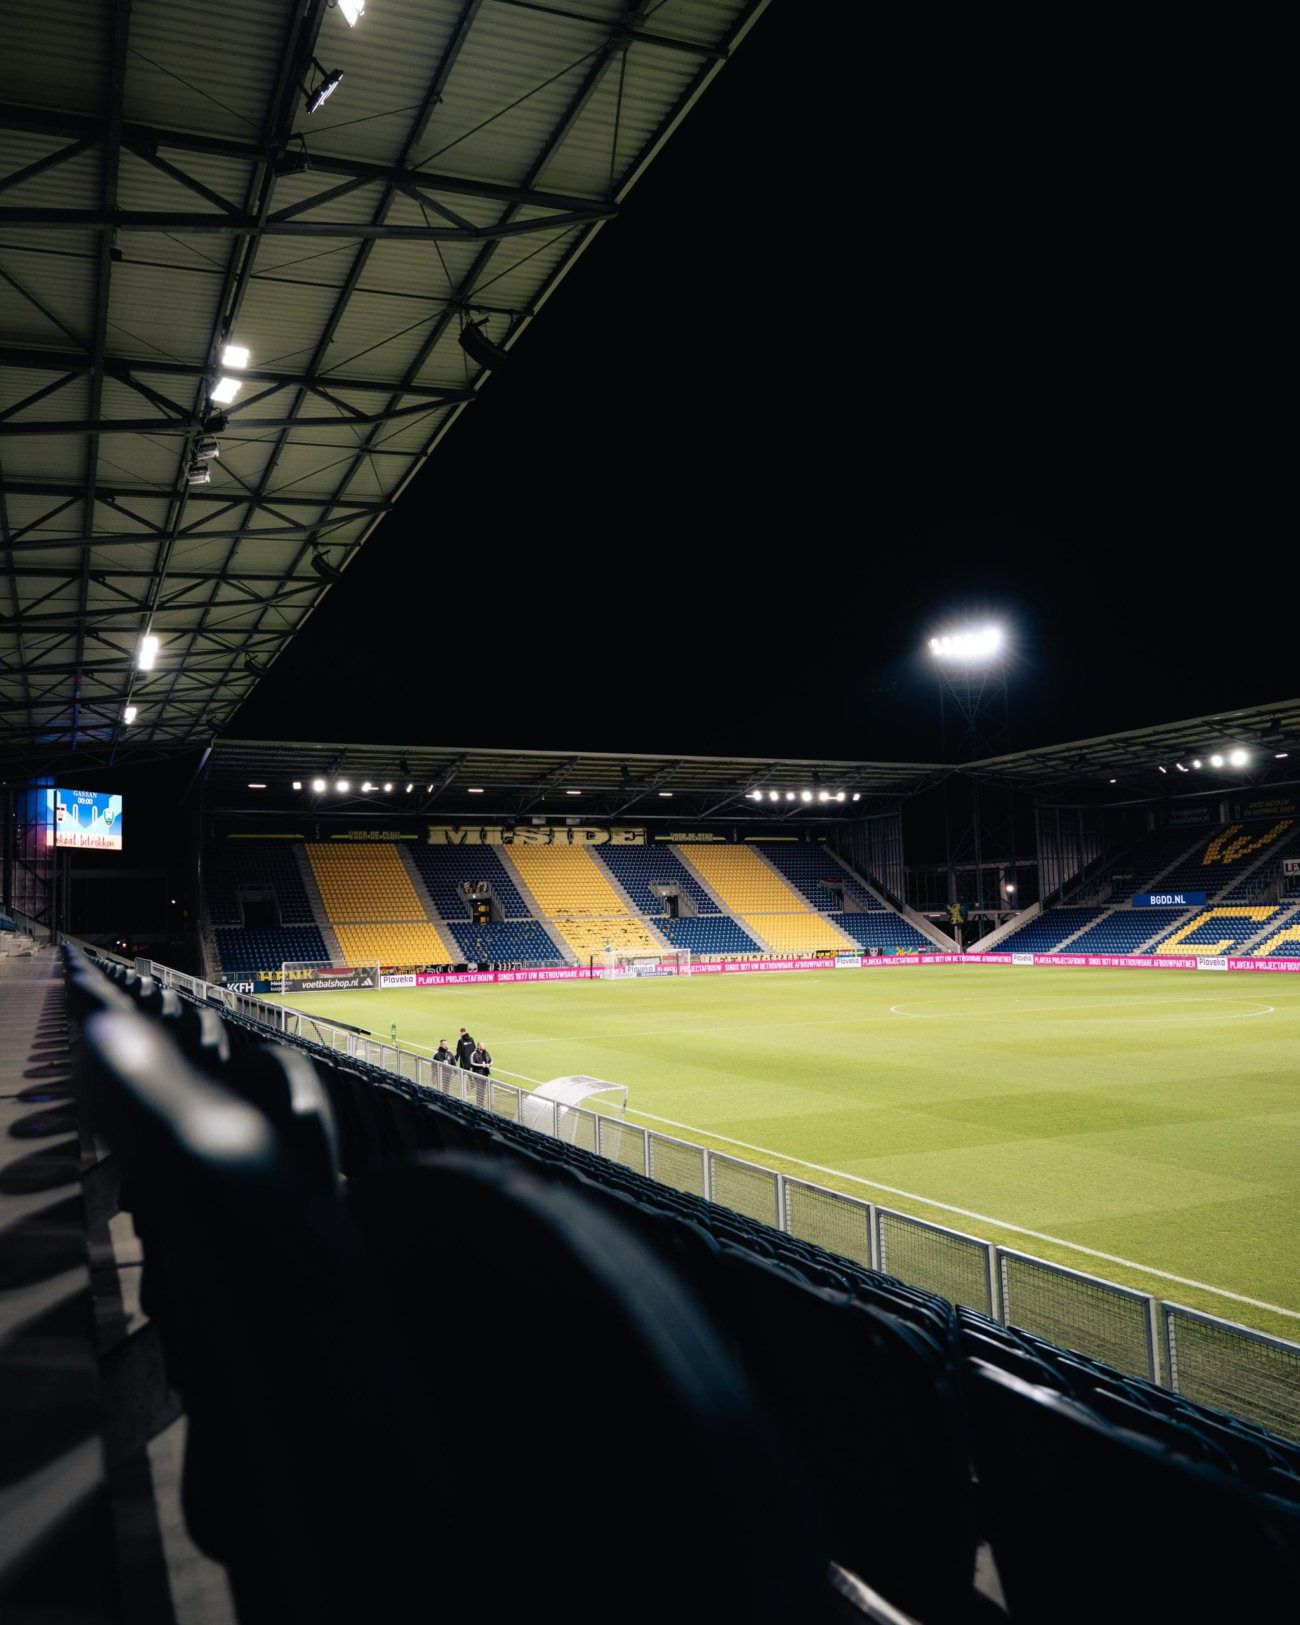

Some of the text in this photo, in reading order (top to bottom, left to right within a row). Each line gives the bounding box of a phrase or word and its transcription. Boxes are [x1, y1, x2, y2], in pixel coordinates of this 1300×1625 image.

[73, 790, 97, 798] GASSAN
[1150, 894, 1186, 905] BGDD.NL
[1199, 956, 1226, 966] Plaveka
[1230, 961, 1254, 970] PLAVEKA
[383, 975, 414, 984] Plaveka
[418, 976, 444, 985] PLAVEKA
[445, 974, 494, 984] PROJECTAFBOUW
[498, 973, 514, 981] SINDS
[515, 972, 527, 981] 1977
[528, 972, 537, 980] UW
[538, 970, 578, 979] BETROUWBARE
[302, 978, 359, 989] voetbalshop.nl
